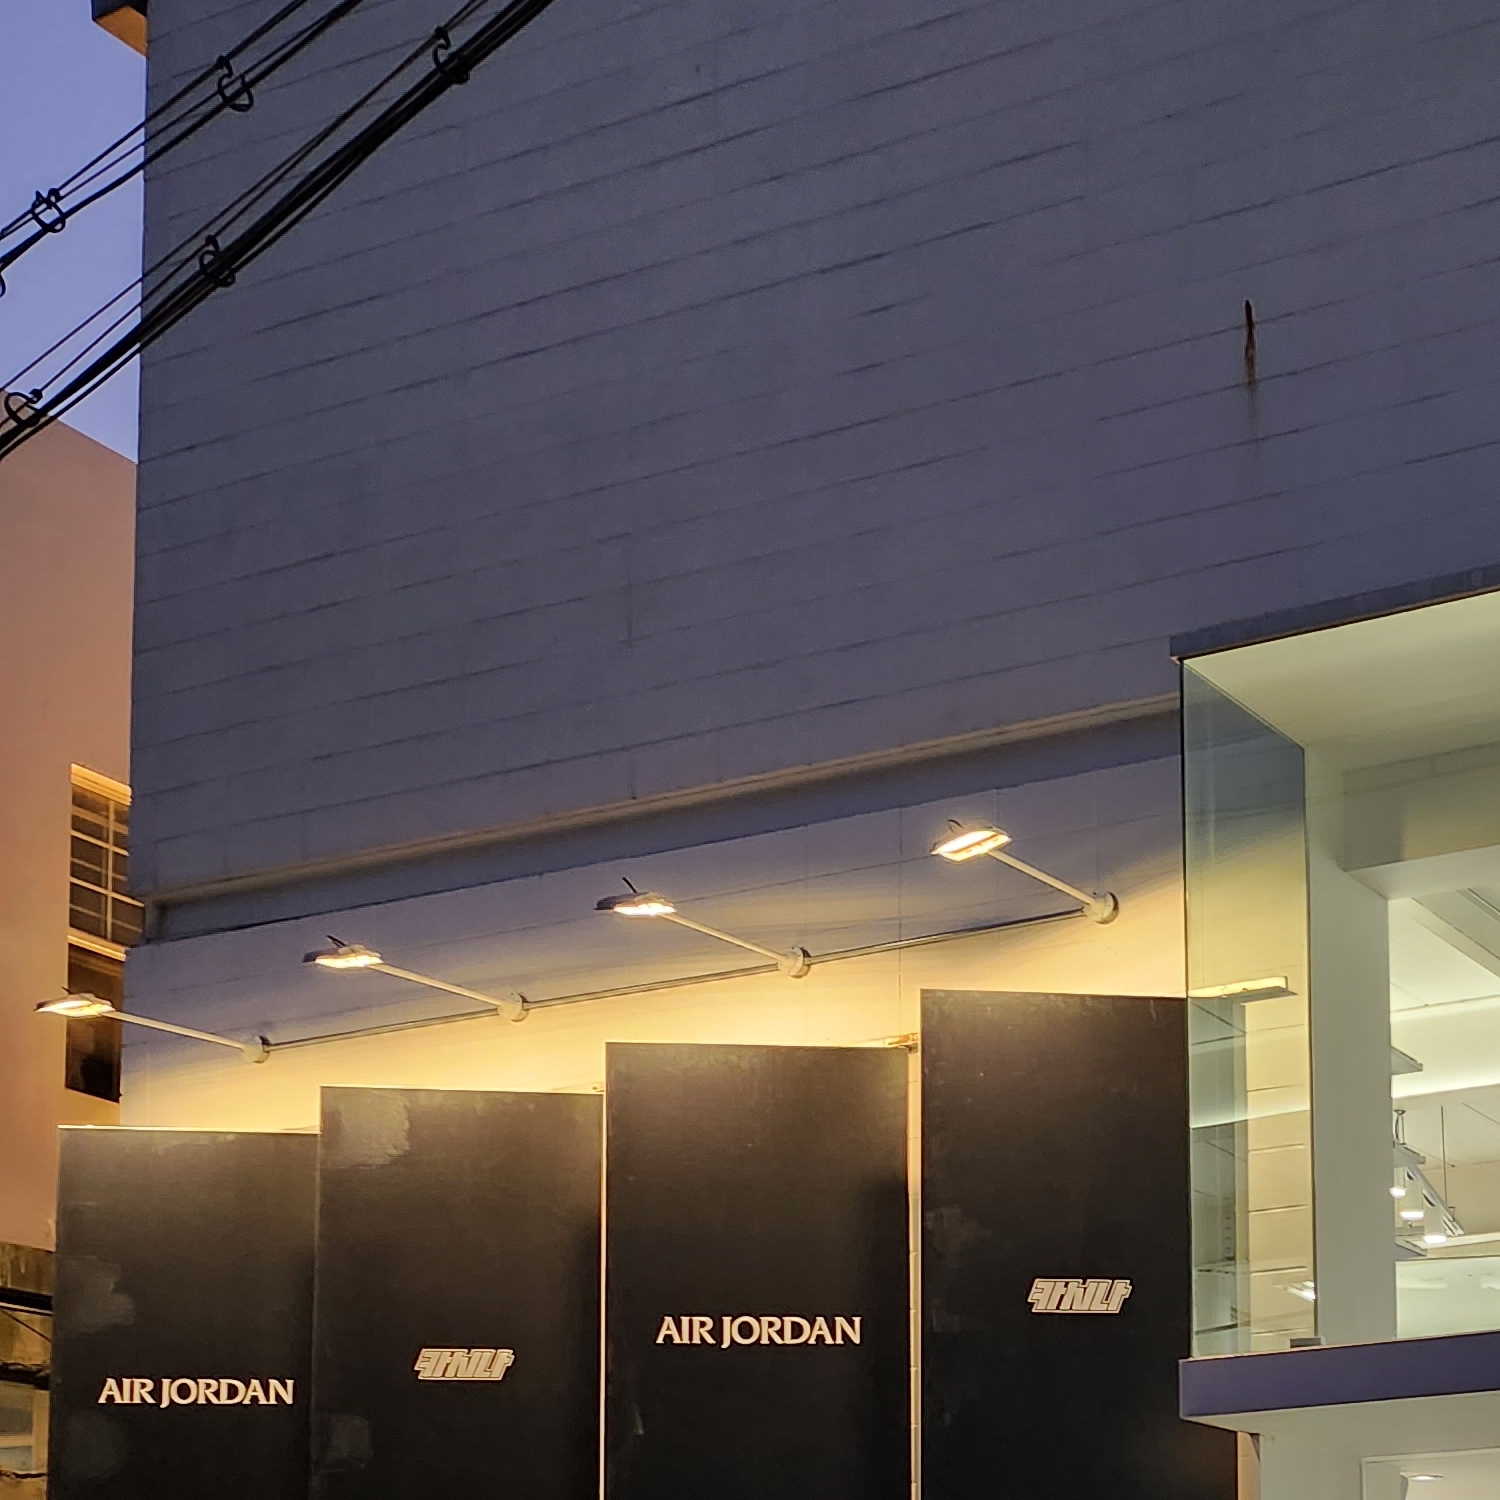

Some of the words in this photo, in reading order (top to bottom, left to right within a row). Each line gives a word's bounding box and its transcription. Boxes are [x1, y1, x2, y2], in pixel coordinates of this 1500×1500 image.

[655, 1316, 717, 1345] AIR
[720, 1315, 862, 1349] JORDAN
[97, 1378, 157, 1405] AIR
[159, 1377, 295, 1409] JORDAN
